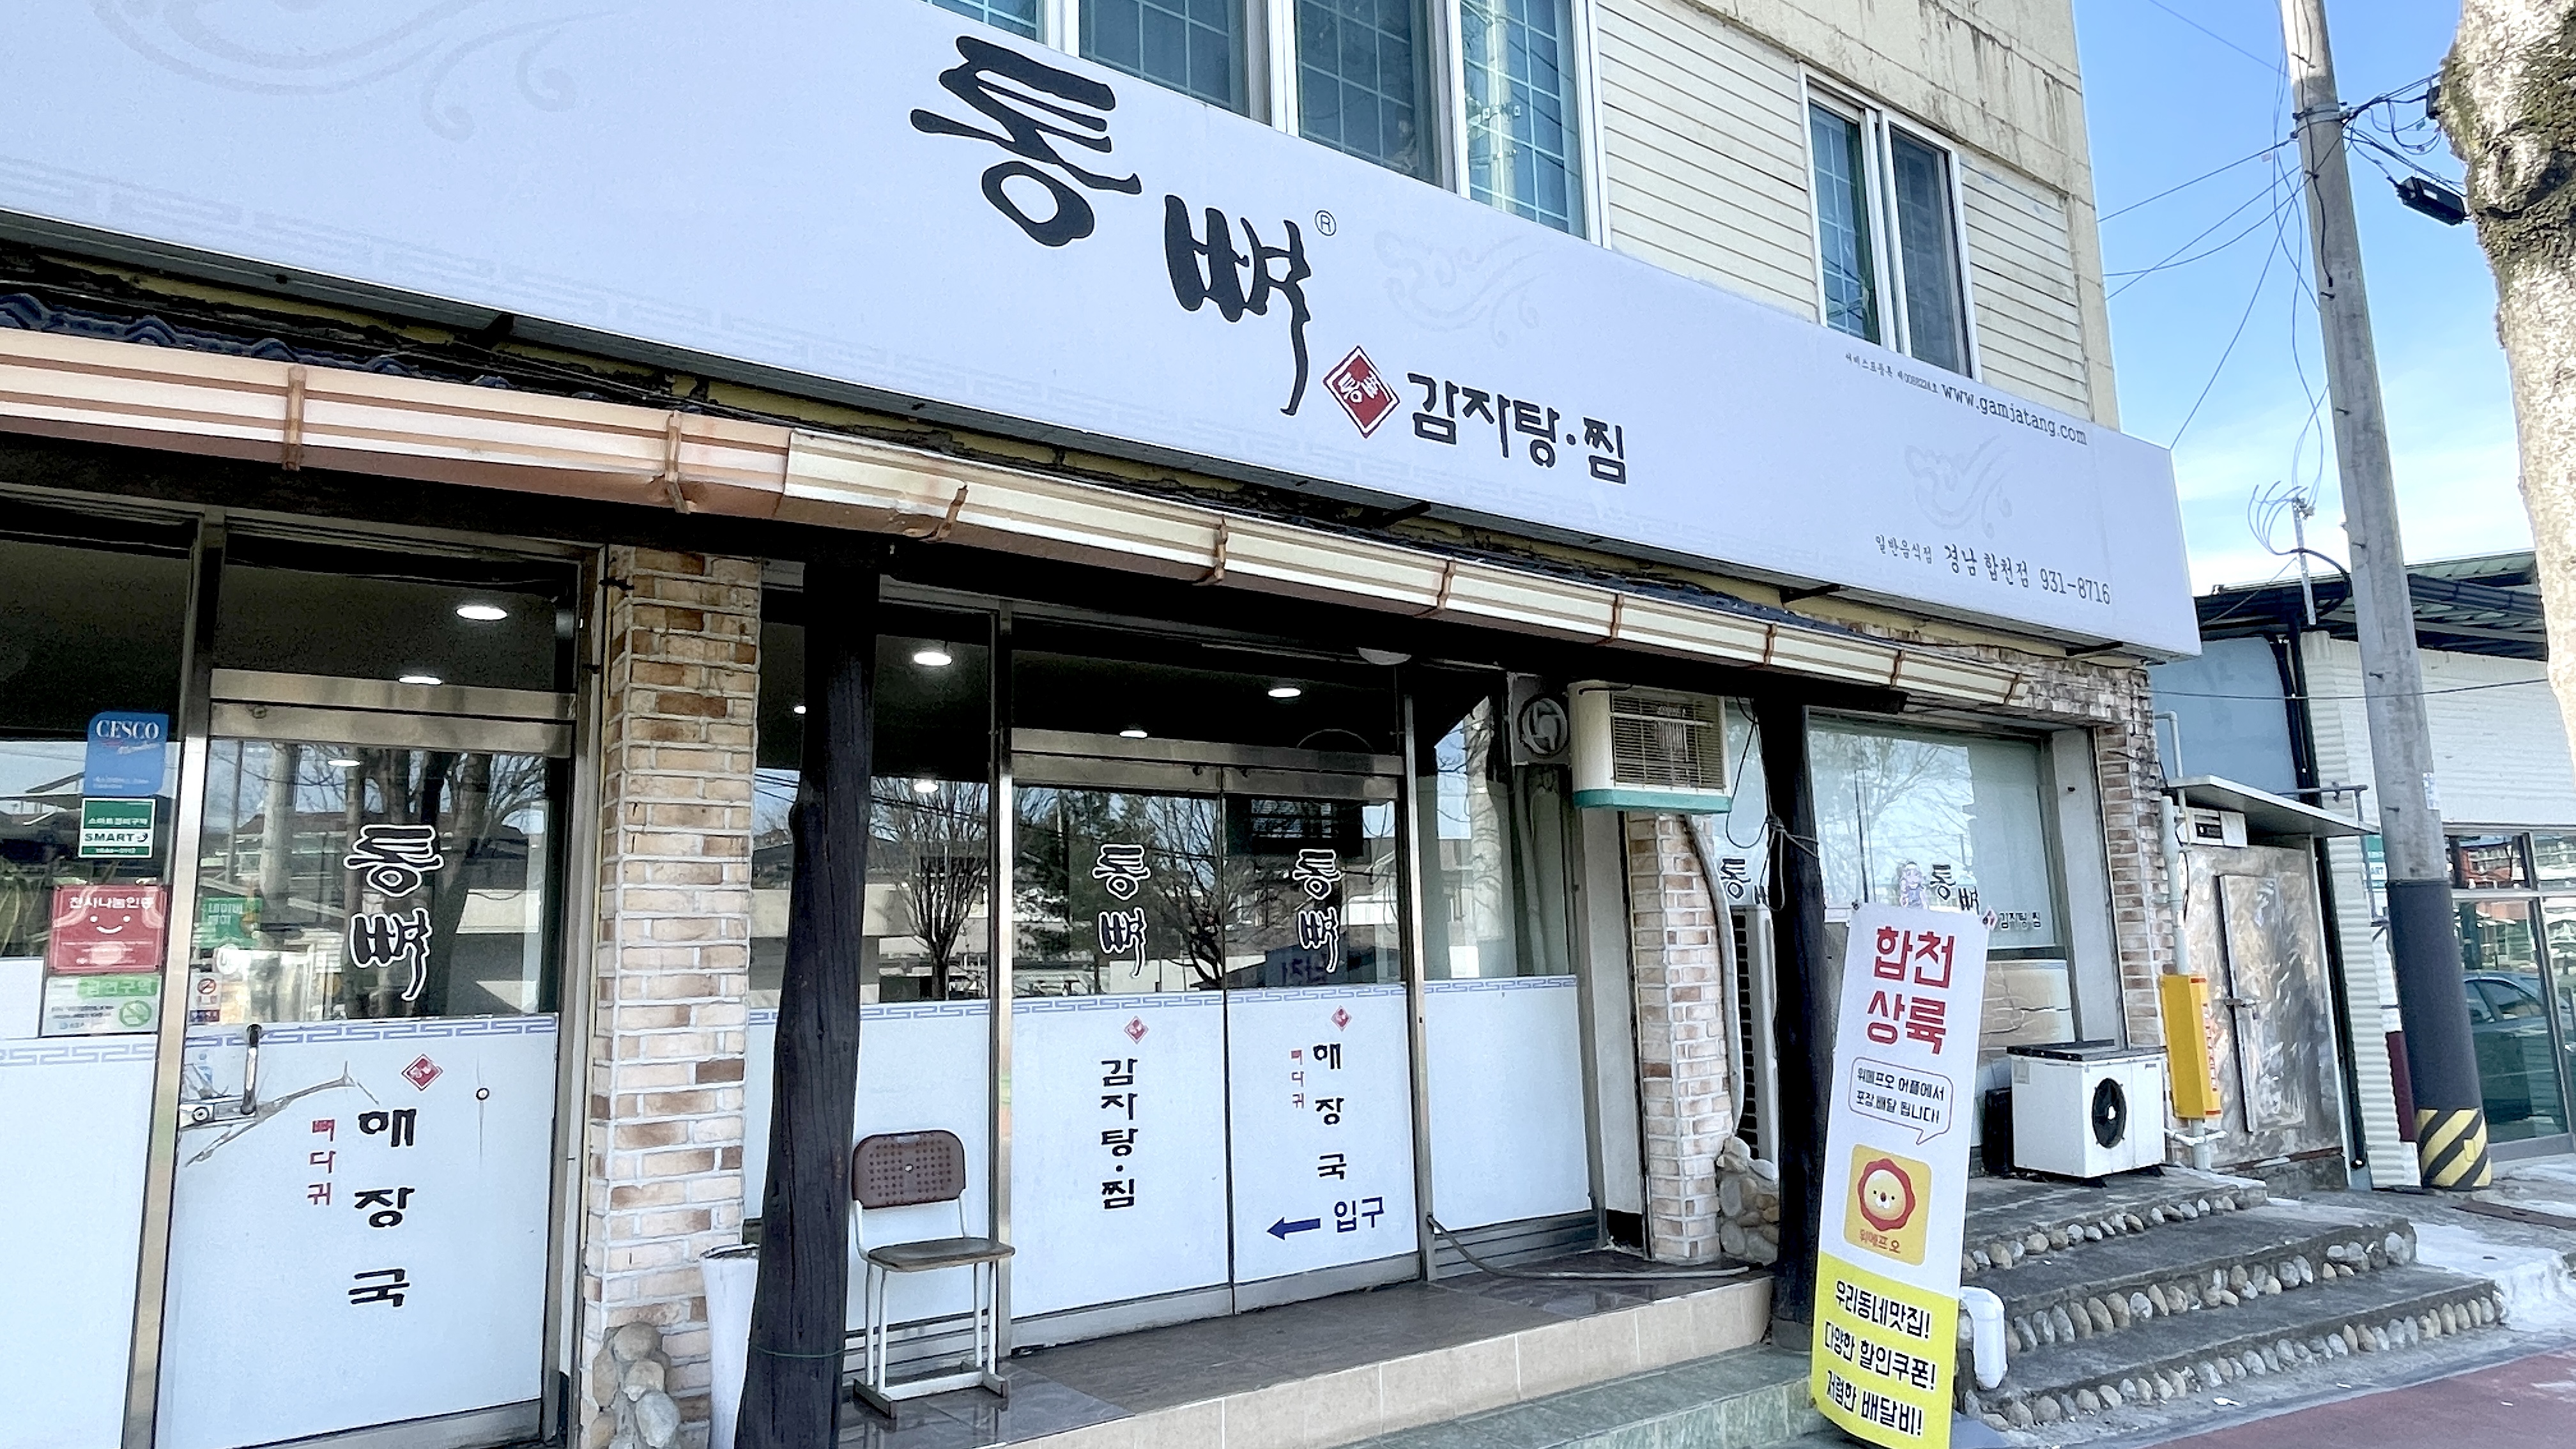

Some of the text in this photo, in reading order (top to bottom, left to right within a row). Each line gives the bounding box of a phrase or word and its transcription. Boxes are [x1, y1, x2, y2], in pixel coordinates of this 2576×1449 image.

[1941, 383, 2088, 446] www.gamjatang.com
[1875, 535, 2111, 606] 일반음식점 경남 합천점 931-8716
[96, 719, 160, 739] CESCO
[84, 833, 135, 842] SMART
[1873, 924, 1955, 989] 합천
[1867, 990, 1946, 1055] 상륙
[1313, 1043, 1347, 1180] 해장국
[1857, 1068, 1945, 1101] 위메프오 어플에서
[348, 1108, 418, 1308] 해장국
[1334, 1197, 1385, 1233] 입구
[1834, 1280, 1931, 1340] 우리동네맛집!
[1824, 1320, 1936, 1390] 다양한 할인쿠폰!
[1825, 1369, 1922, 1437] 저렴한 배달비!
